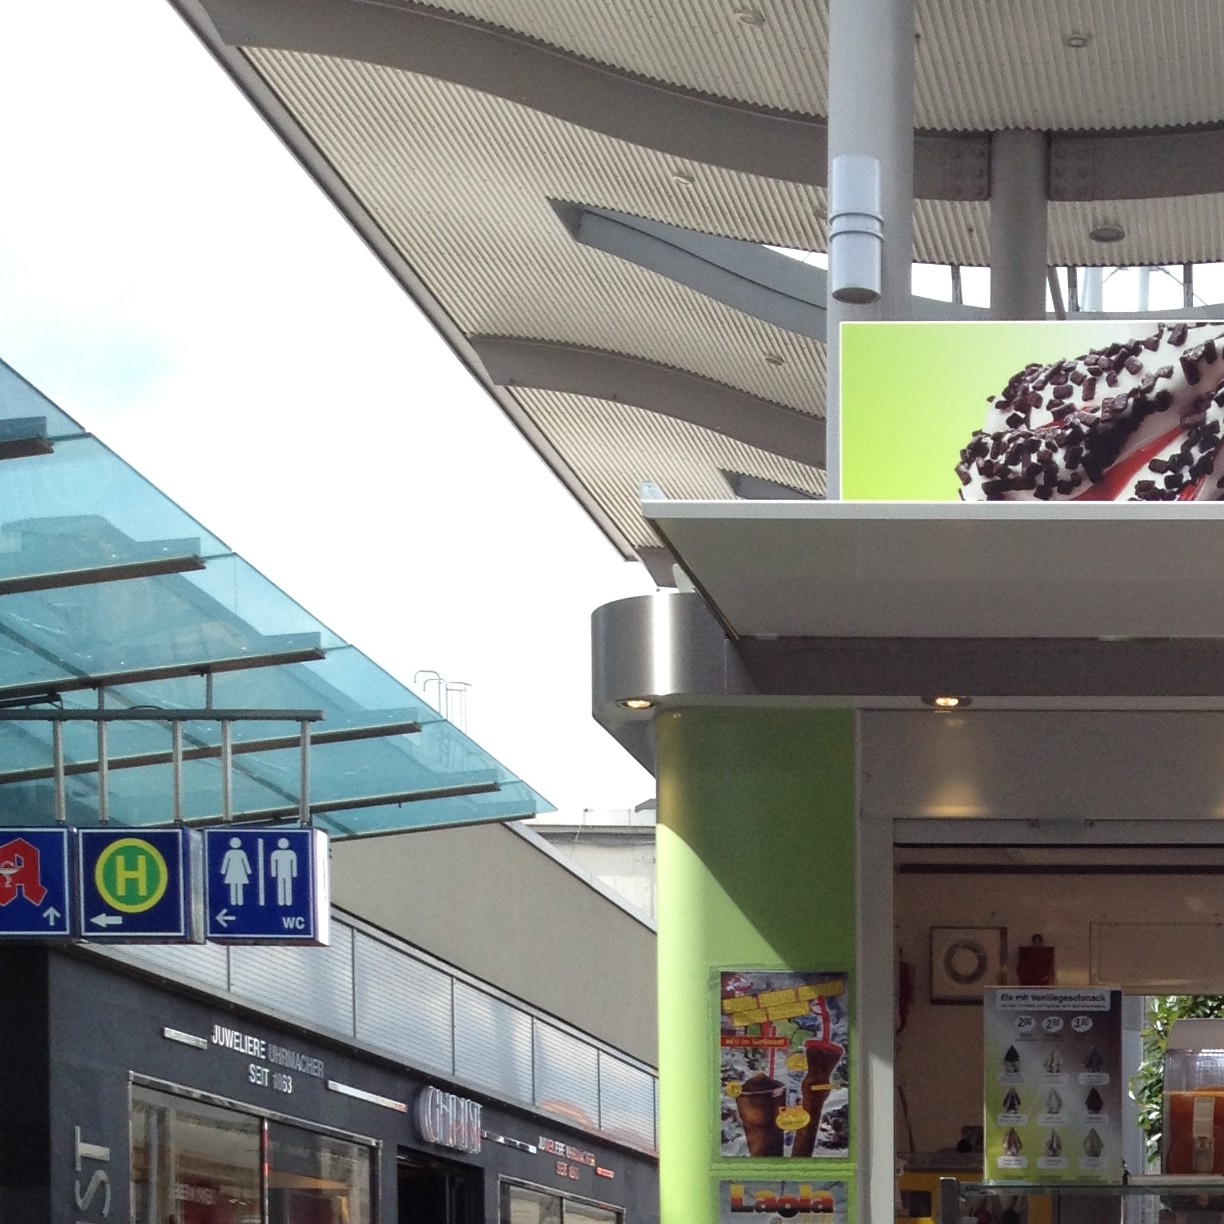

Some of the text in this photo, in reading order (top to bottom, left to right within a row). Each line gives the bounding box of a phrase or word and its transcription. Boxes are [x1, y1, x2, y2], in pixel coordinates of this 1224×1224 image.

[114, 854, 147, 897] H
[281, 916, 305, 930] WC
[212, 1024, 324, 1078] JUWELIERE UHRMACHER
[249, 1063, 270, 1087] SEIT
[730, 1183, 834, 1218] Laola
